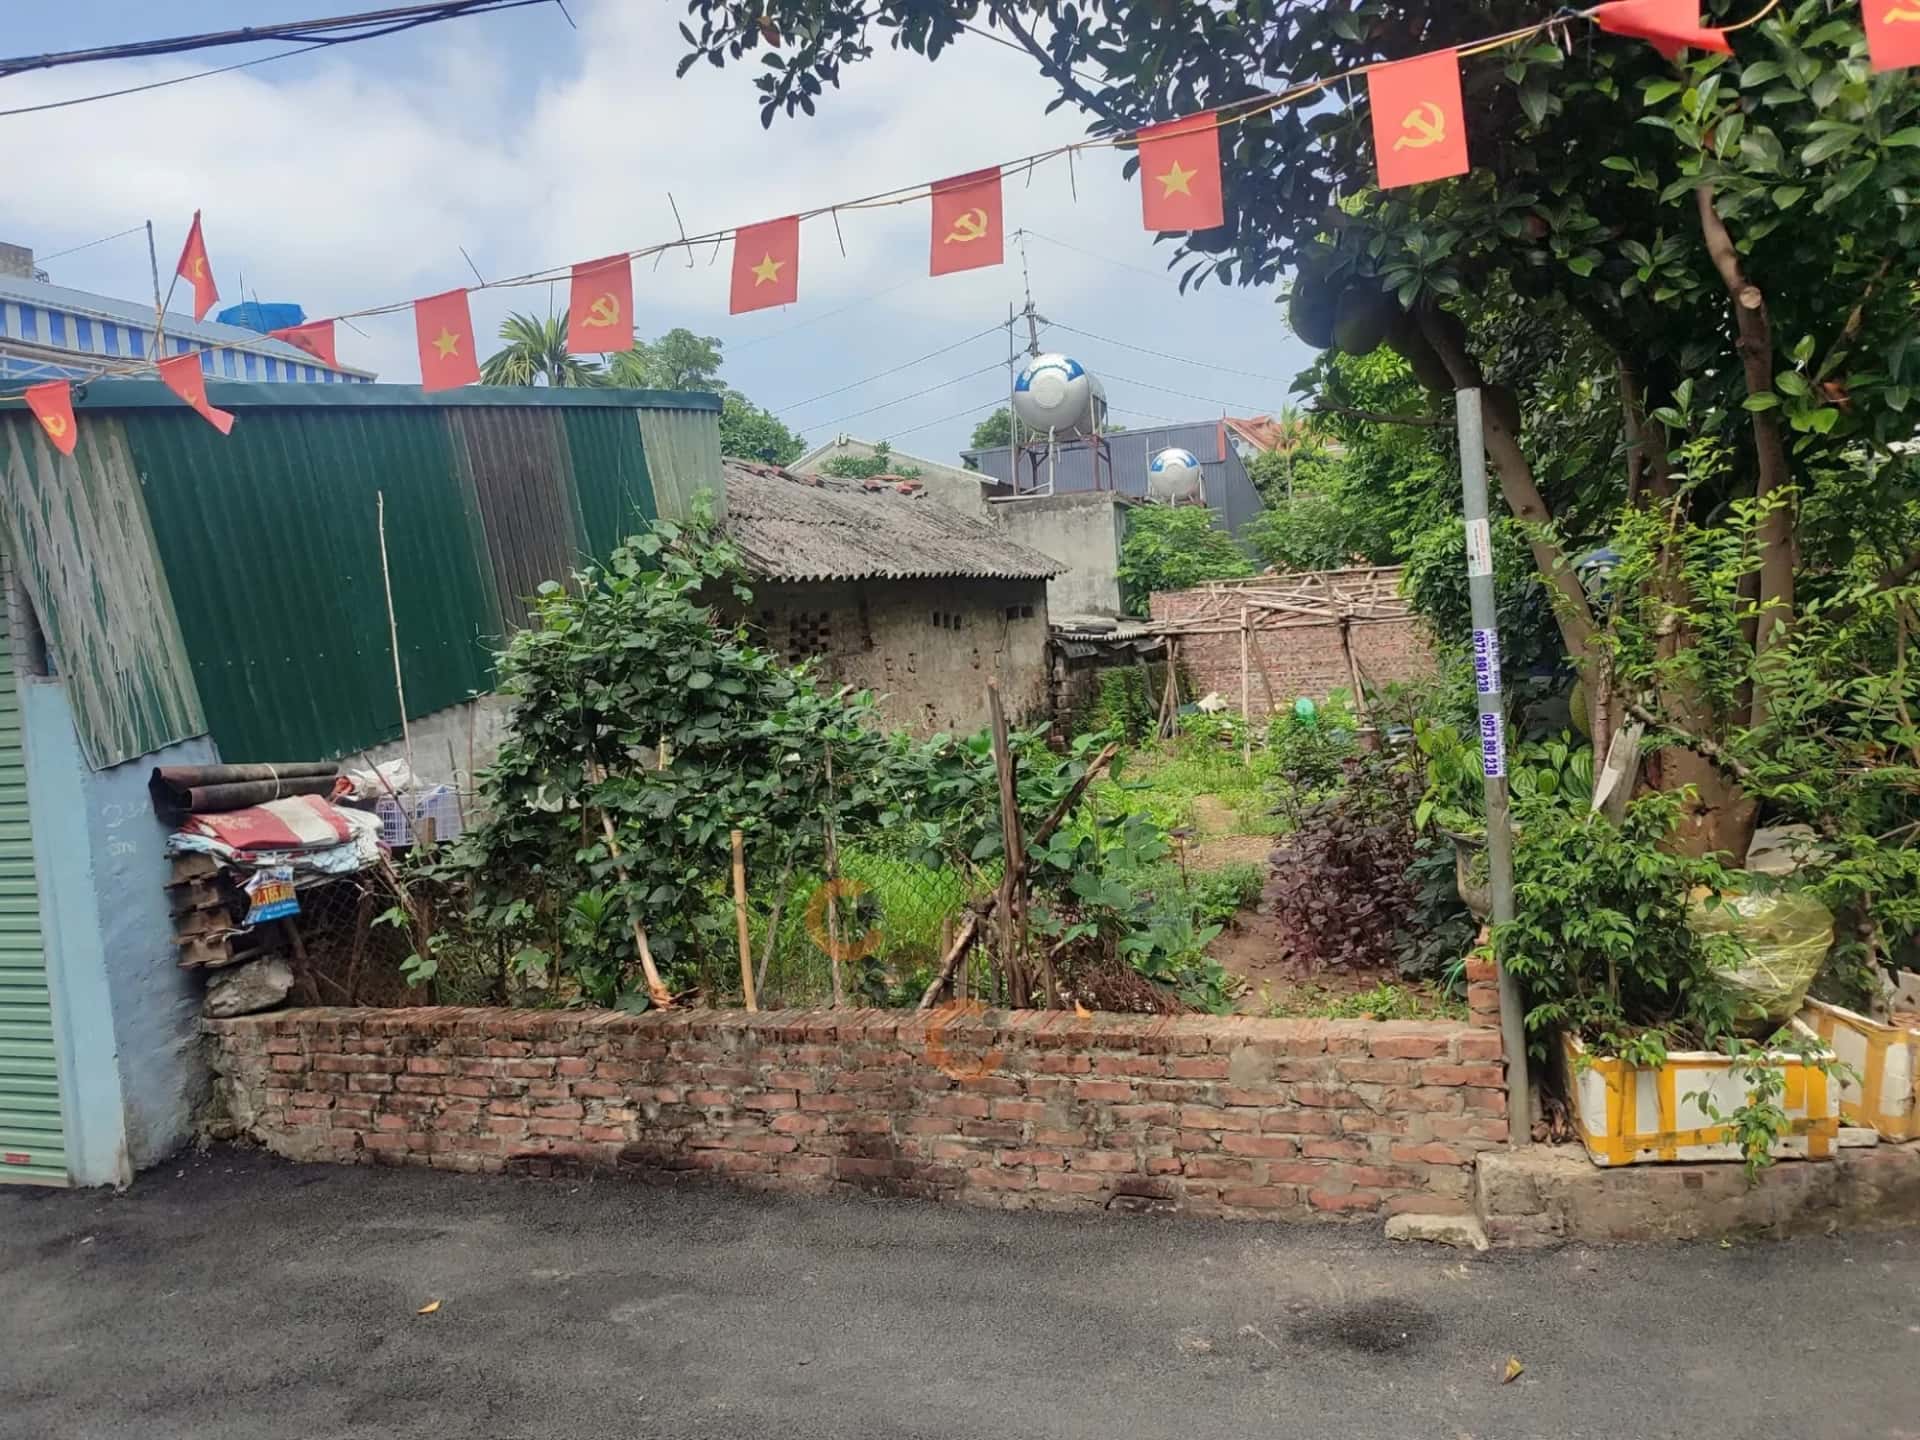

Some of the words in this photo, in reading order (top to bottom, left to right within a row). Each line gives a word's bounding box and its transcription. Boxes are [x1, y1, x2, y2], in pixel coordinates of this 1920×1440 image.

[1474, 631, 1486, 654] 0973
[1476, 656, 1488, 672] 891
[1478, 675, 1489, 692] 238
[1482, 714, 1496, 737] 0973
[1484, 740, 1496, 755] 891
[1485, 758, 1498, 775] 238
